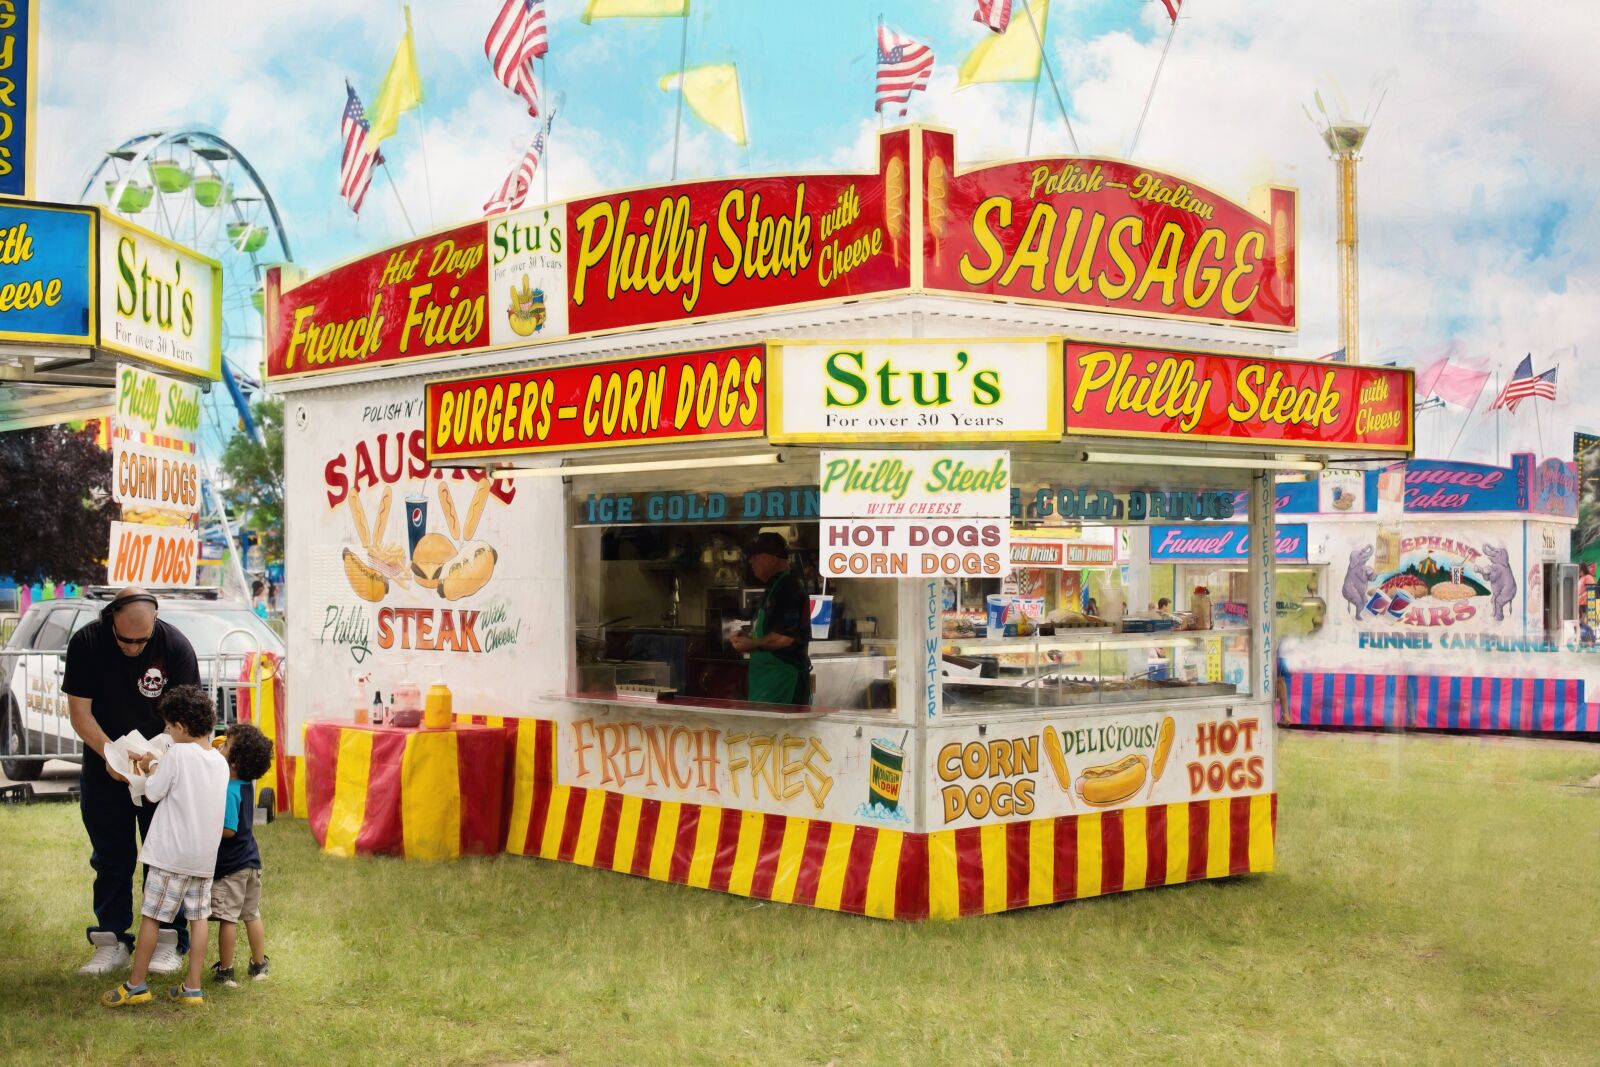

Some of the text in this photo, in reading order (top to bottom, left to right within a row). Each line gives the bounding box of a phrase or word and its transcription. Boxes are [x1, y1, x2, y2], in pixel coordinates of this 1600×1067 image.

[819, 183, 861, 241] with
[0, 222, 34, 265] ith
[493, 210, 562, 267] Stu's
[572, 181, 813, 313] Philly Steak
[817, 226, 882, 289] Cheese
[959, 195, 1266, 315] SAUSAGE
[378, 239, 485, 289] Hot Dogs
[494, 255, 562, 281] For over 30 Years
[0, 277, 62, 313] eese
[116, 236, 194, 338] Stu's
[115, 321, 193, 363] For over 30 Years
[285, 282, 486, 370] French Fries
[825, 351, 1002, 407] Stu's
[1072, 350, 1341, 432] Philly Steak
[1359, 376, 1389, 405] with
[117, 370, 200, 432] Philly Steak
[362, 402, 403, 422] POLISH
[436, 377, 555, 449] BURGERS
[583, 364, 667, 437] CORN
[674, 355, 763, 431] DOGS
[826, 412, 1005, 427] For over 30 Years
[1355, 410, 1401, 436] Cheese
[119, 451, 197, 507] CORN DOGS
[821, 457, 1008, 500] Philly Steak
[586, 489, 821, 522] ICE COLD DRIN
[866, 502, 962, 515] WITH CHEESE
[1036, 488, 1115, 517] COLD
[1128, 490, 1236, 520] DRINKS
[828, 525, 1001, 547] HOT DOGS
[1031, 546, 1059, 562] Drinks
[1157, 529, 1235, 554] Funnel
[113, 531, 194, 585] HOT DOGS
[828, 552, 1001, 575] CORN DOGS
[321, 604, 483, 665] Philly STEAK
[1404, 602, 1477, 627] ARS
[926, 582, 938, 719] ICE WATER
[1262, 622, 1271, 694] WATER
[1358, 632, 1433, 649] FUNNEL
[937, 734, 1040, 783] CORN
[1061, 720, 1159, 755] DELICIOUS!
[1195, 717, 1259, 757] HOT
[571, 718, 833, 810] FRENCH FRIES
[1187, 756, 1265, 795] DOGS
[942, 778, 1036, 825] DOGS
